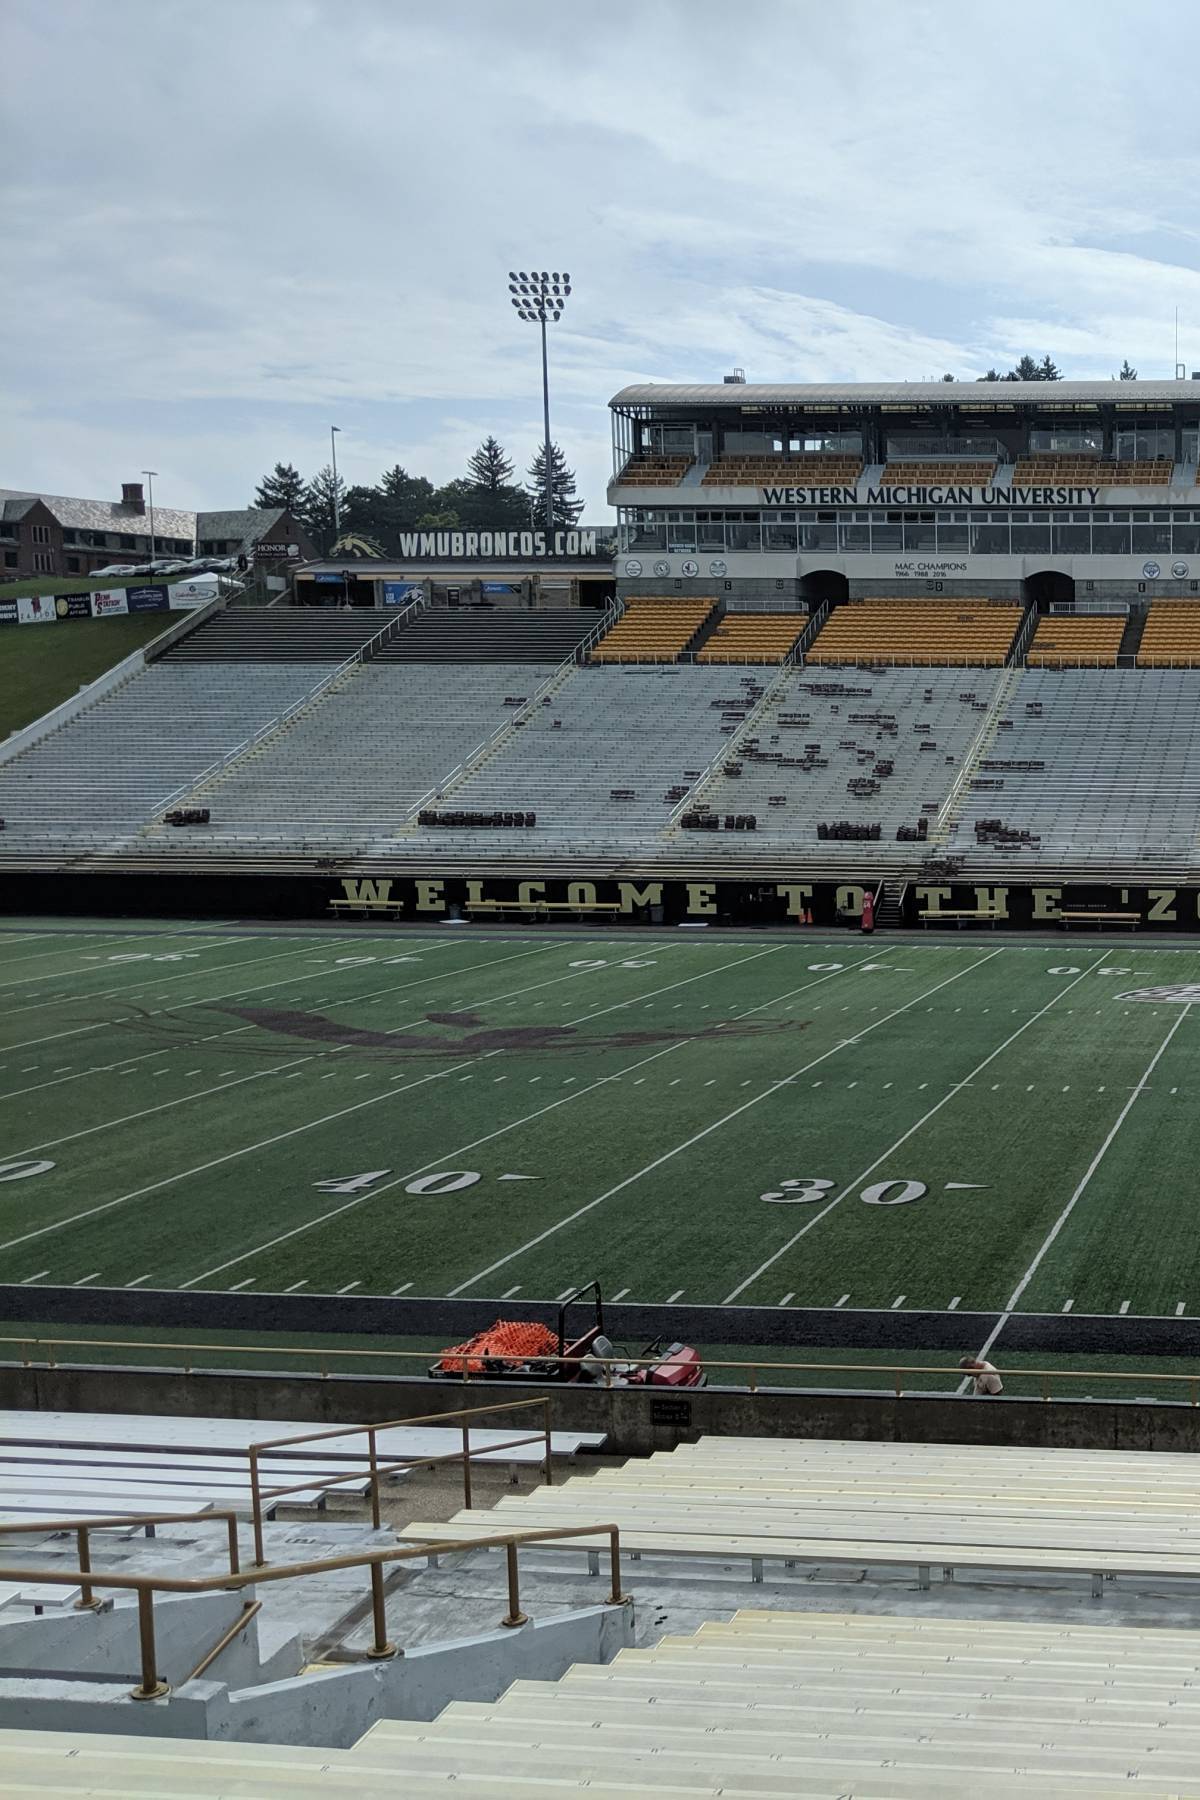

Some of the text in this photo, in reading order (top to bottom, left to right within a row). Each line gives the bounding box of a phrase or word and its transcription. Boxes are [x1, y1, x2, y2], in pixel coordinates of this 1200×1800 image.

[763, 487, 1100, 505] WESTERN MICHIGAN UNIVERSITY
[257, 544, 287, 552] HONOR
[400, 531, 596, 557] WMUBRONCOS.COM
[895, 563, 967, 571] MAC CHAMPIONS
[341, 879, 718, 915] WELCOME
[777, 885, 865, 917] TO
[915, 887, 1063, 919] THE
[568, 959, 658, 968] 50
[1047, 966, 1133, 976] 30
[311, 1169, 482, 1195] 40
[759, 1178, 927, 1206] 30
